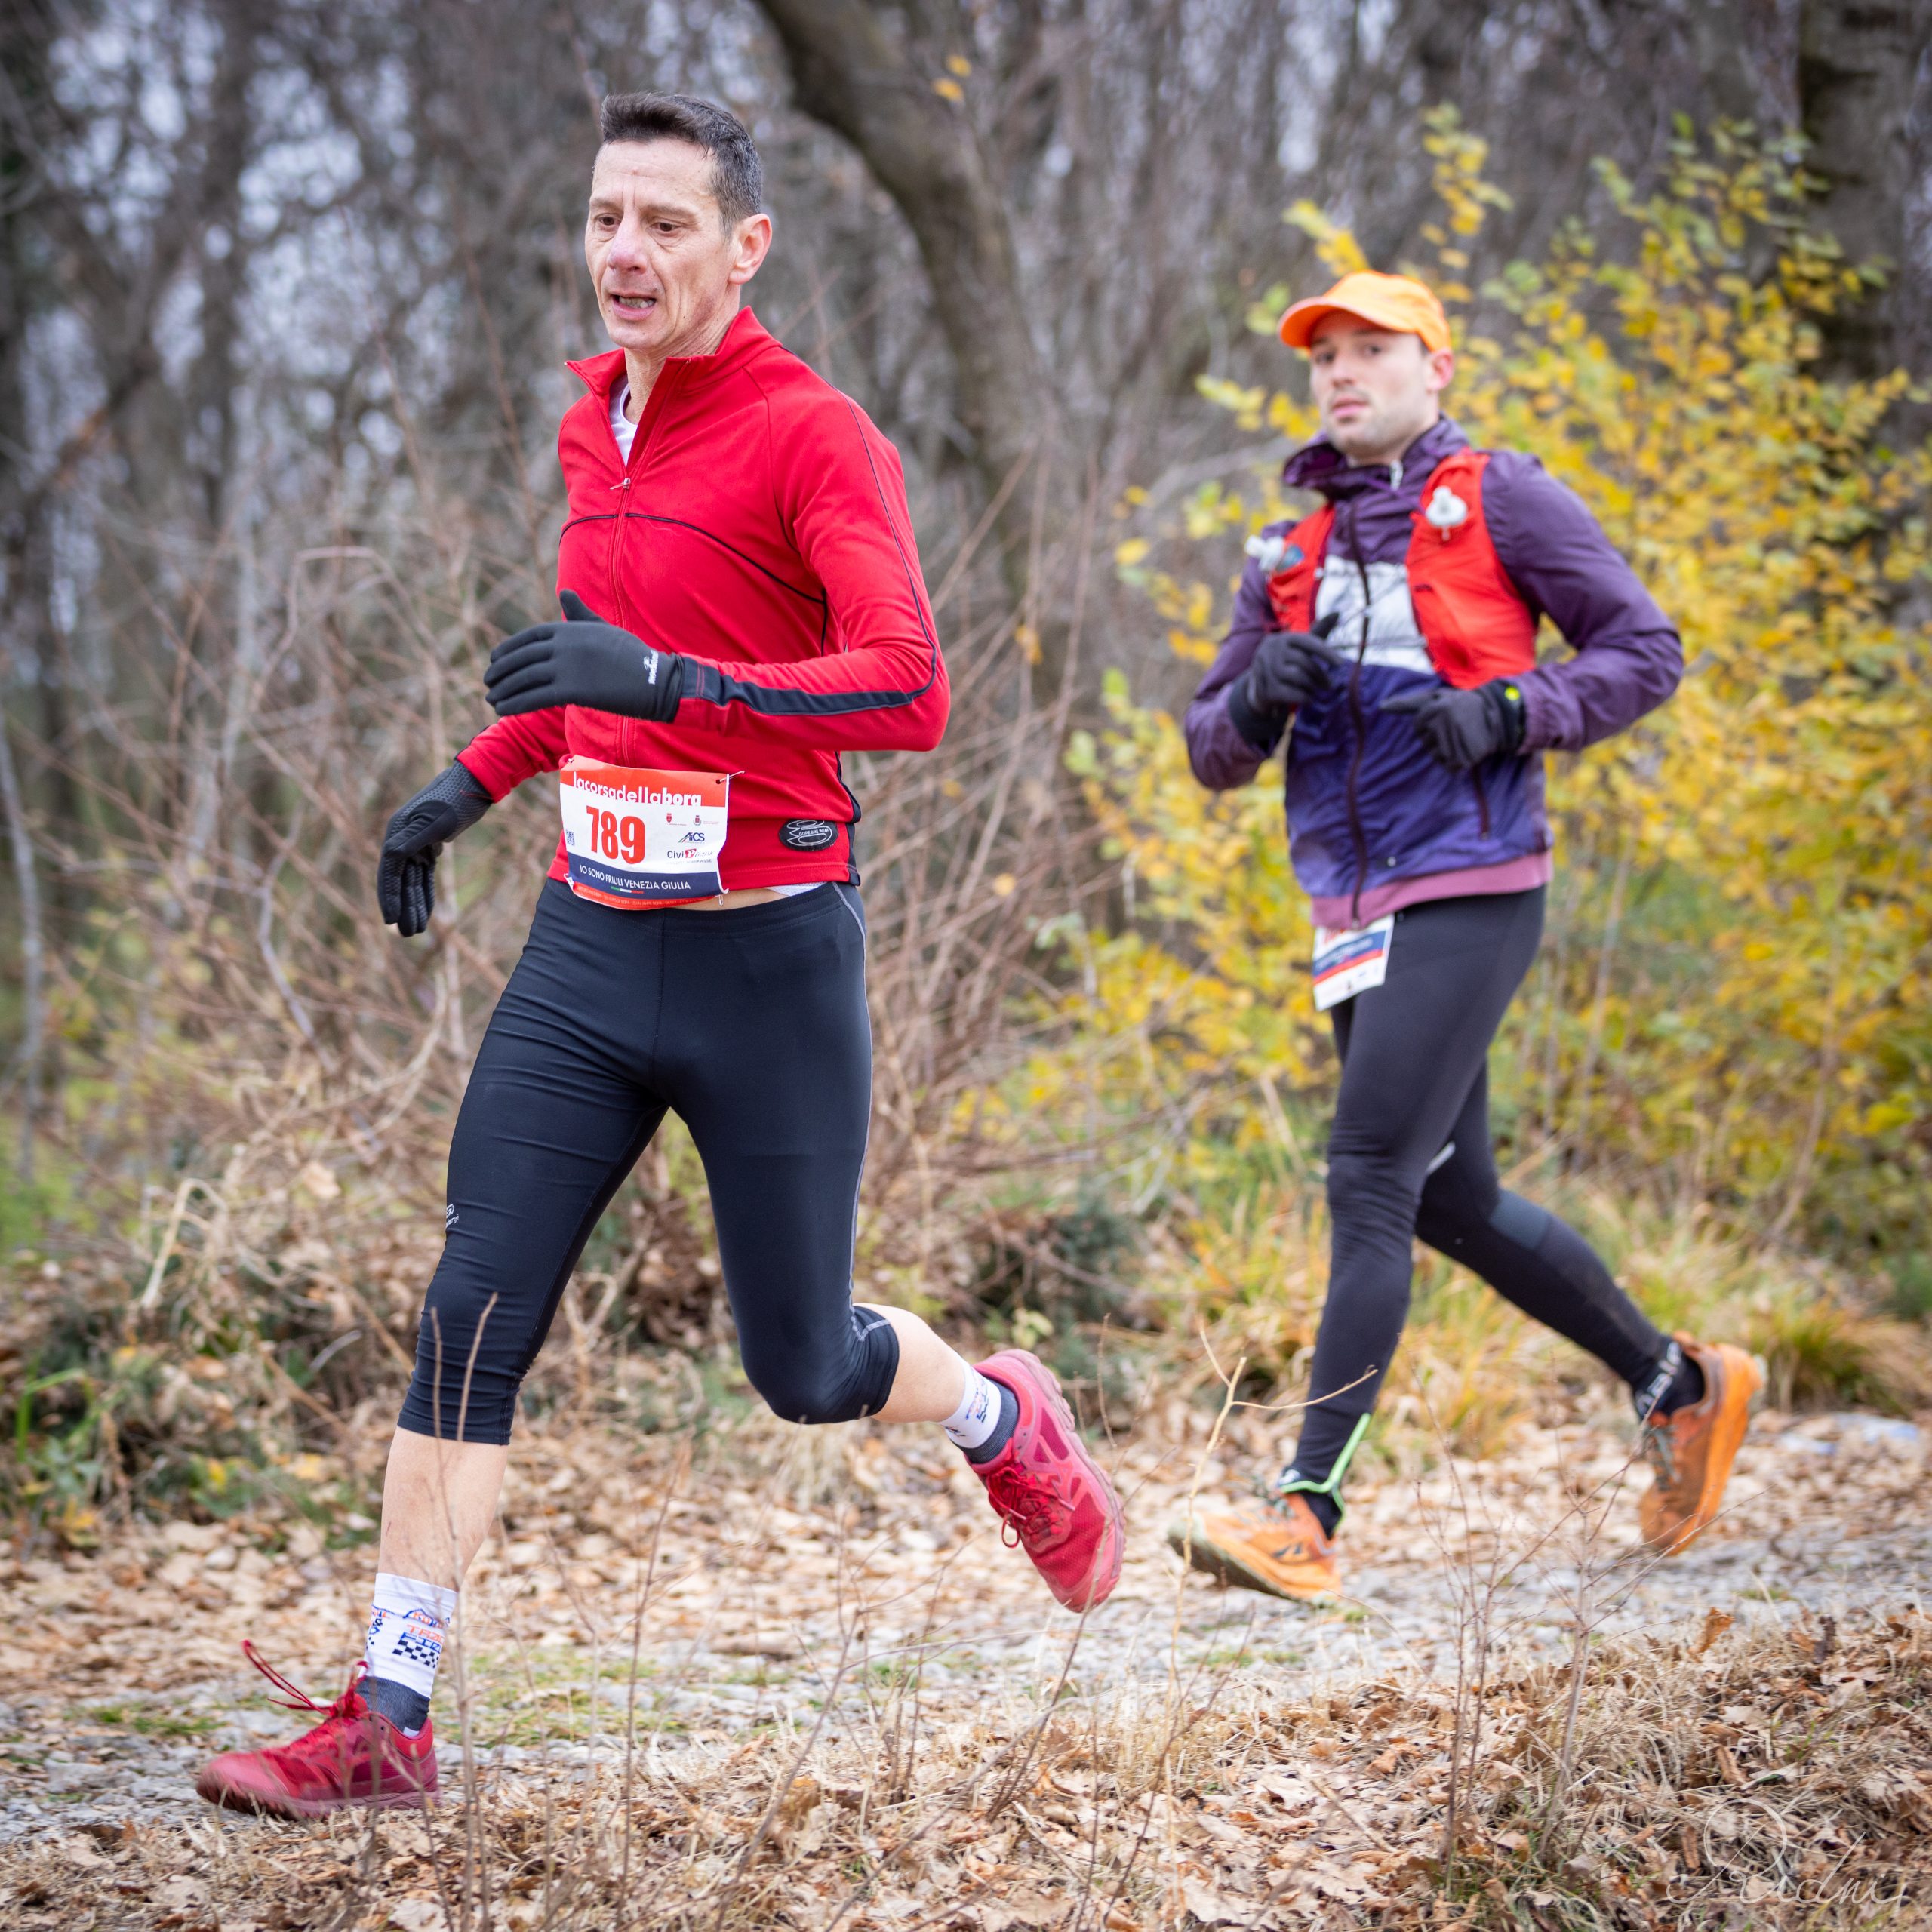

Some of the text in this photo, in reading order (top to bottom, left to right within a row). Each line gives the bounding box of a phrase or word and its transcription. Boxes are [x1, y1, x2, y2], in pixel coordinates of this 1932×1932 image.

[586, 805, 645, 864] 789
[580, 865, 691, 890] IO SONO FRIULI VENEZIA GIULIA
